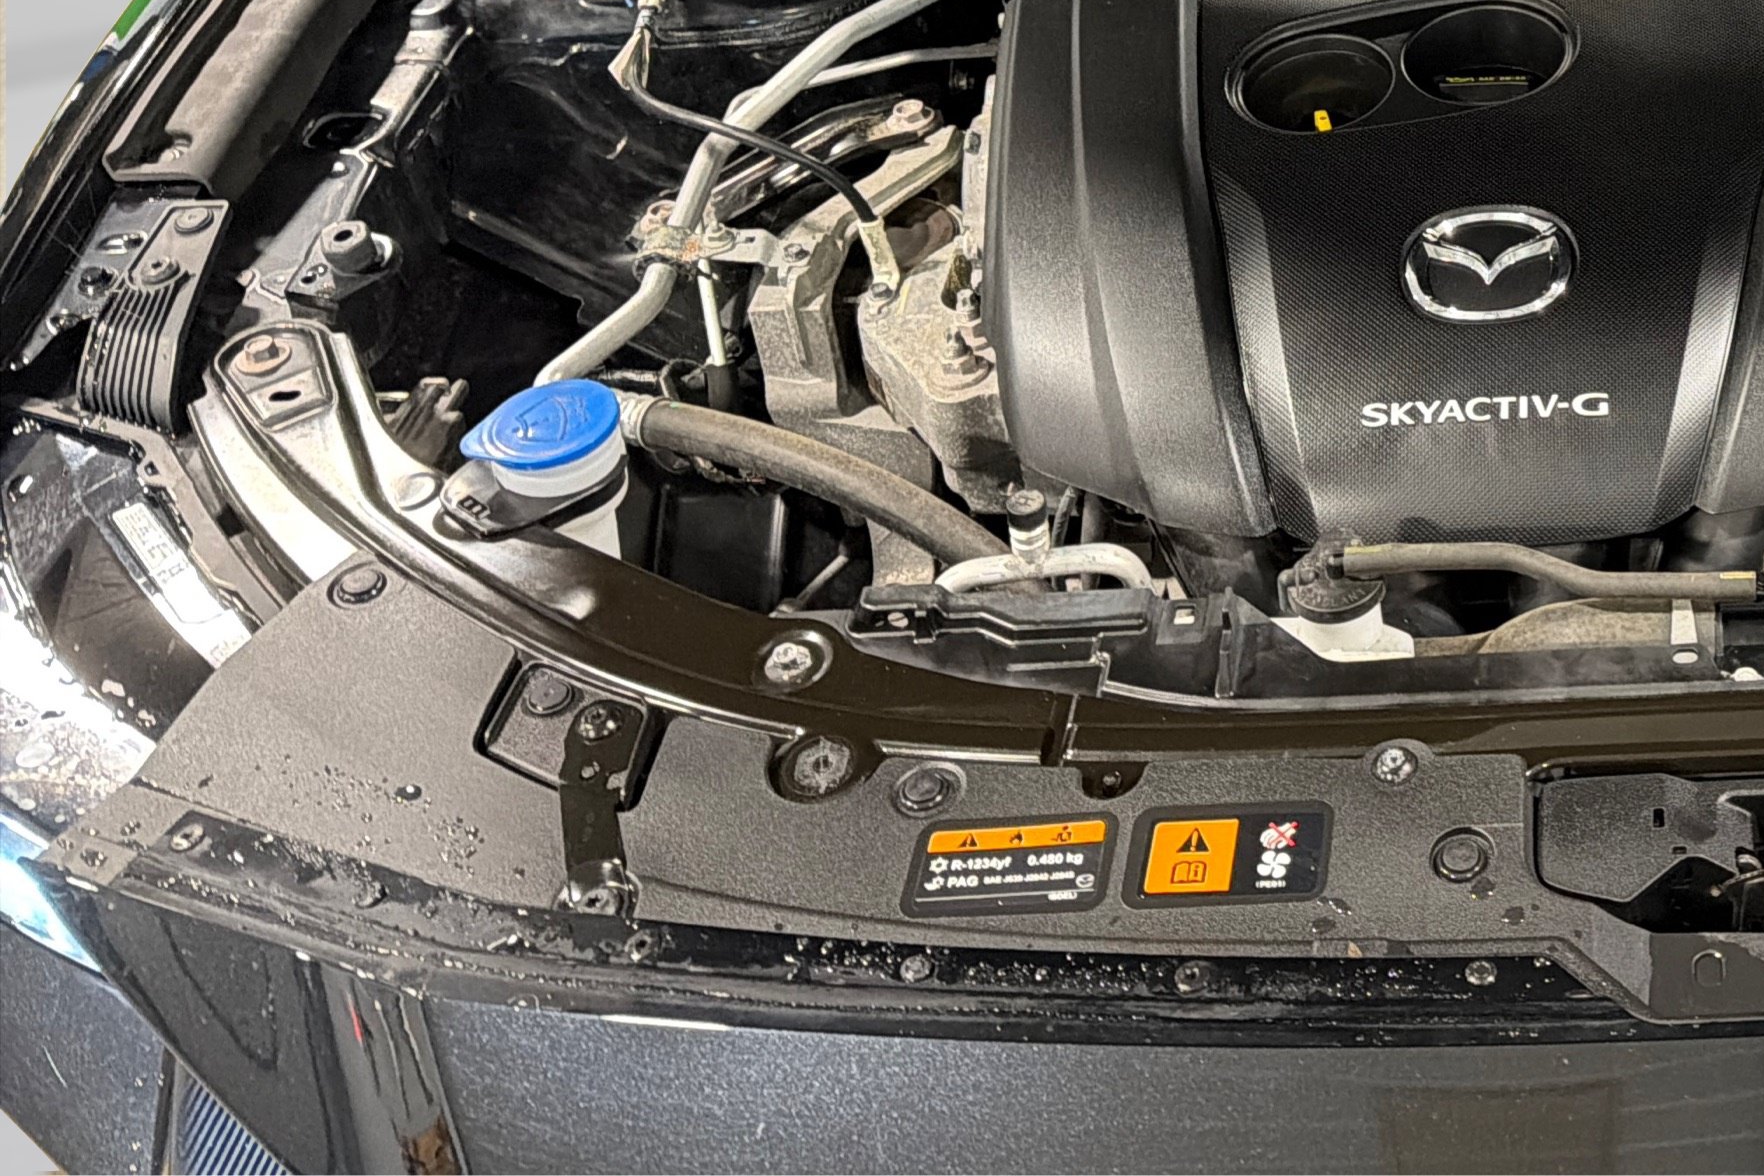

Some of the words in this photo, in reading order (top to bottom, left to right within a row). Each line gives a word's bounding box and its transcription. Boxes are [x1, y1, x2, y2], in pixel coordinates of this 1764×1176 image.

[1361, 392, 1609, 427] SKYACTIV-G
[950, 855, 1013, 872] R-1234yf
[1065, 852, 1085, 866] kg
[946, 875, 979, 889] PAG
